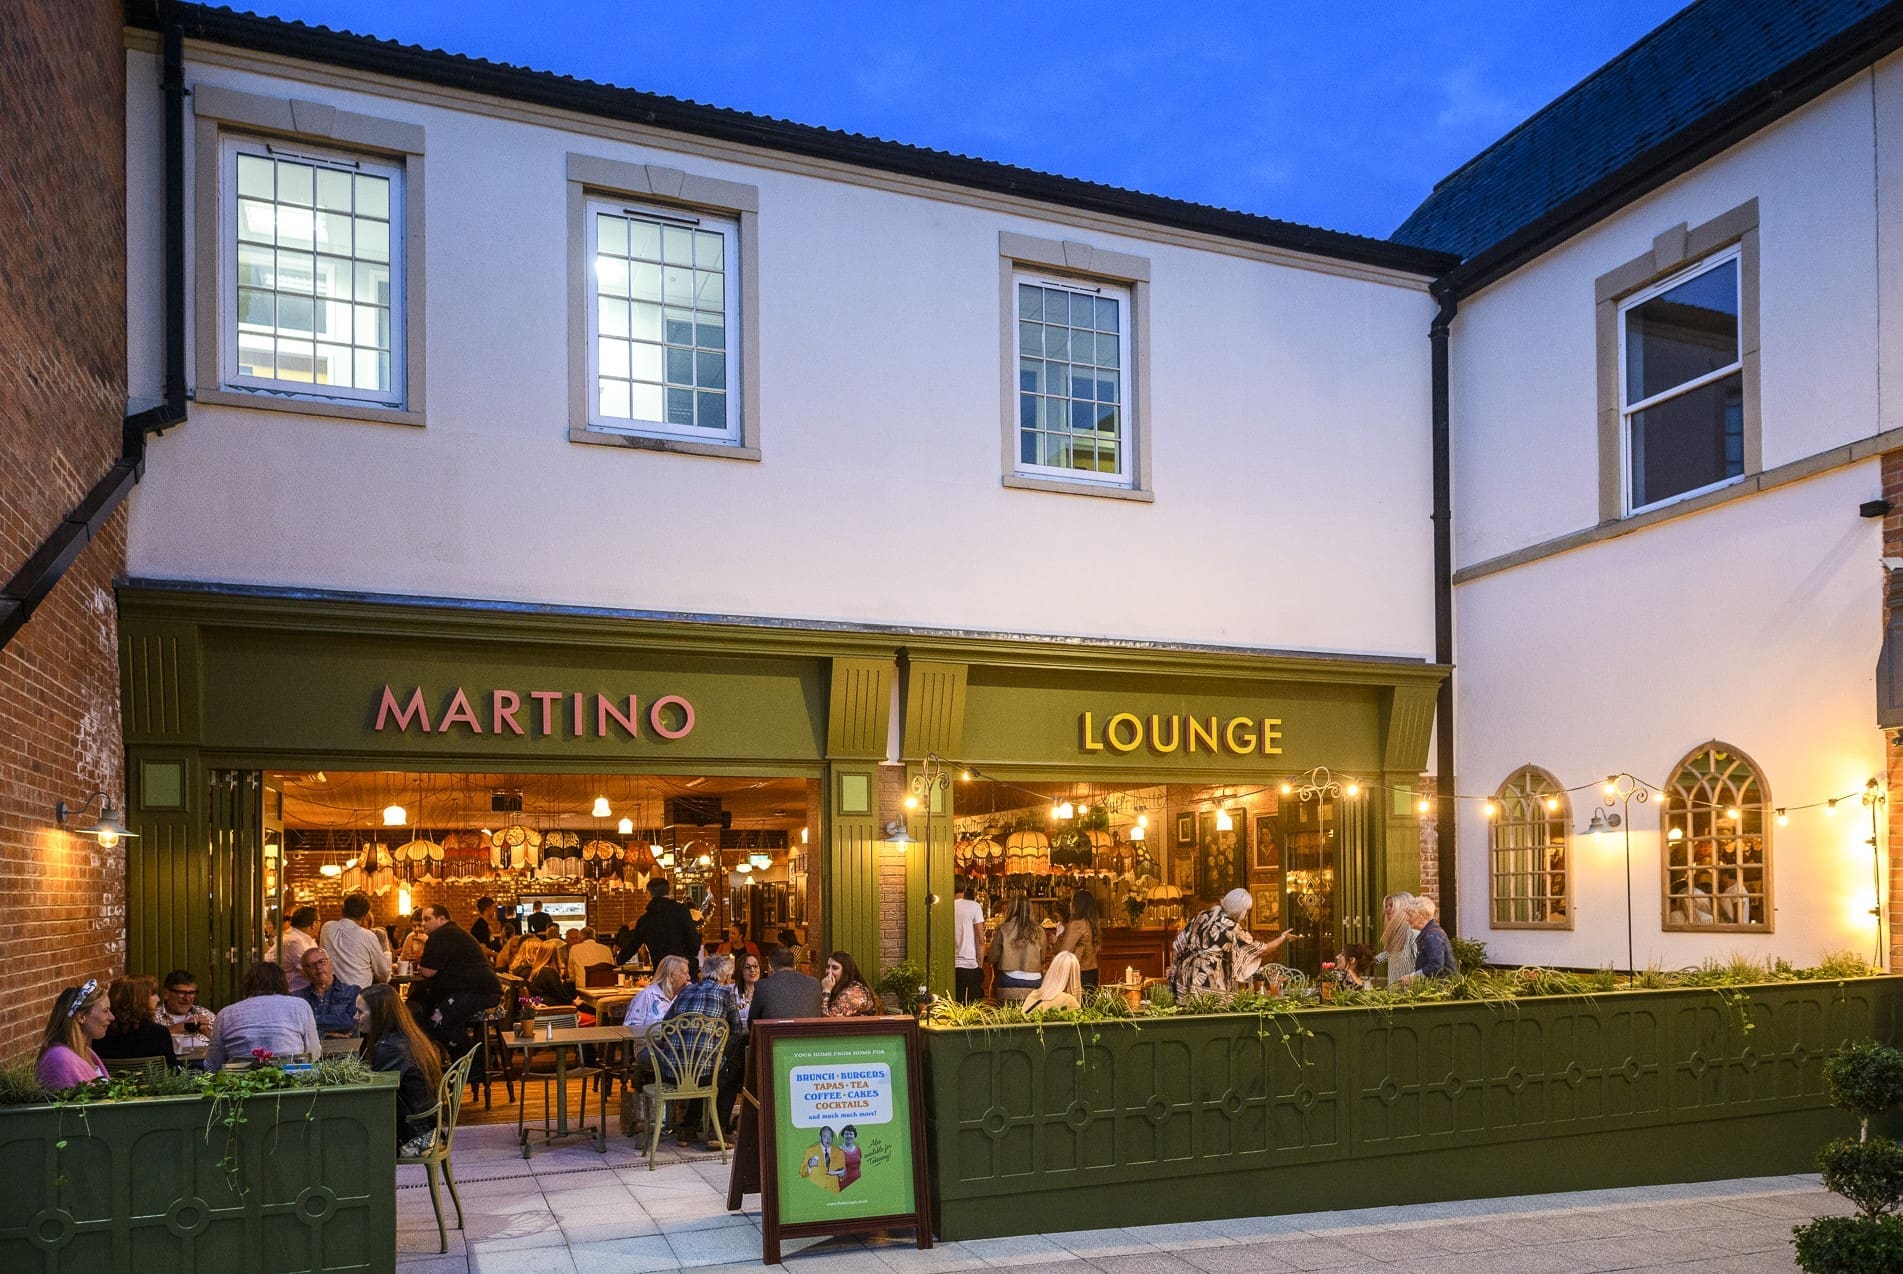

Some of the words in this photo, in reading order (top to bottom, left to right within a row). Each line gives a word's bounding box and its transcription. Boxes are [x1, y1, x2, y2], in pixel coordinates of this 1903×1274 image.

[375, 684, 695, 739] MARTINO
[1083, 711, 1282, 754] LOUNGE
[796, 1072, 835, 1082] BRUNCH
[840, 1070, 885, 1080] BURGERS
[814, 1082, 844, 1091] TAPAS
[850, 1081, 869, 1089] TEA
[804, 1091, 842, 1101] COFFEE
[847, 1090, 879, 1099] CAKES
[815, 1100, 869, 1110] COCKTAILS
[808, 1112, 820, 1120] and
